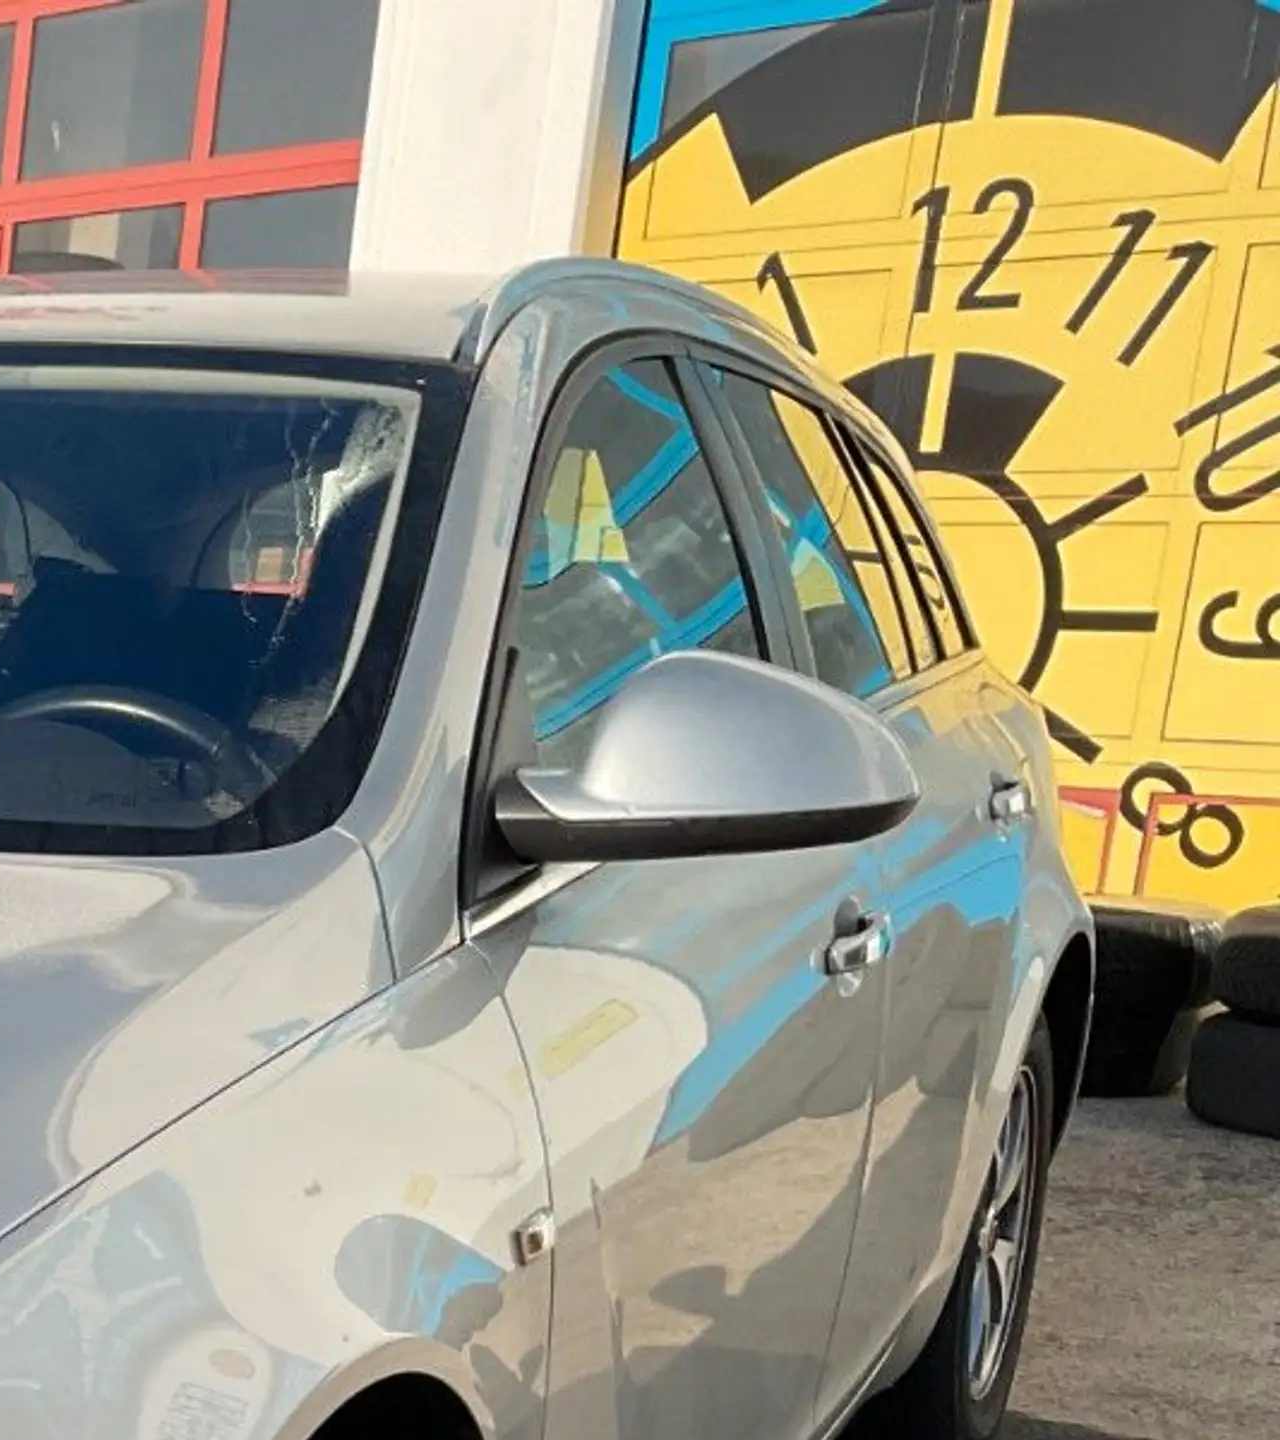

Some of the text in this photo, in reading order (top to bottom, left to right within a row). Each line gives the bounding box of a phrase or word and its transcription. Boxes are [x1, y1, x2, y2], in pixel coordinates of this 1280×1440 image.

[756, 251, 822, 354] 1
[912, 177, 1034, 313] 12
[1065, 209, 1215, 366] 11
[1120, 761, 1242, 868] 8
